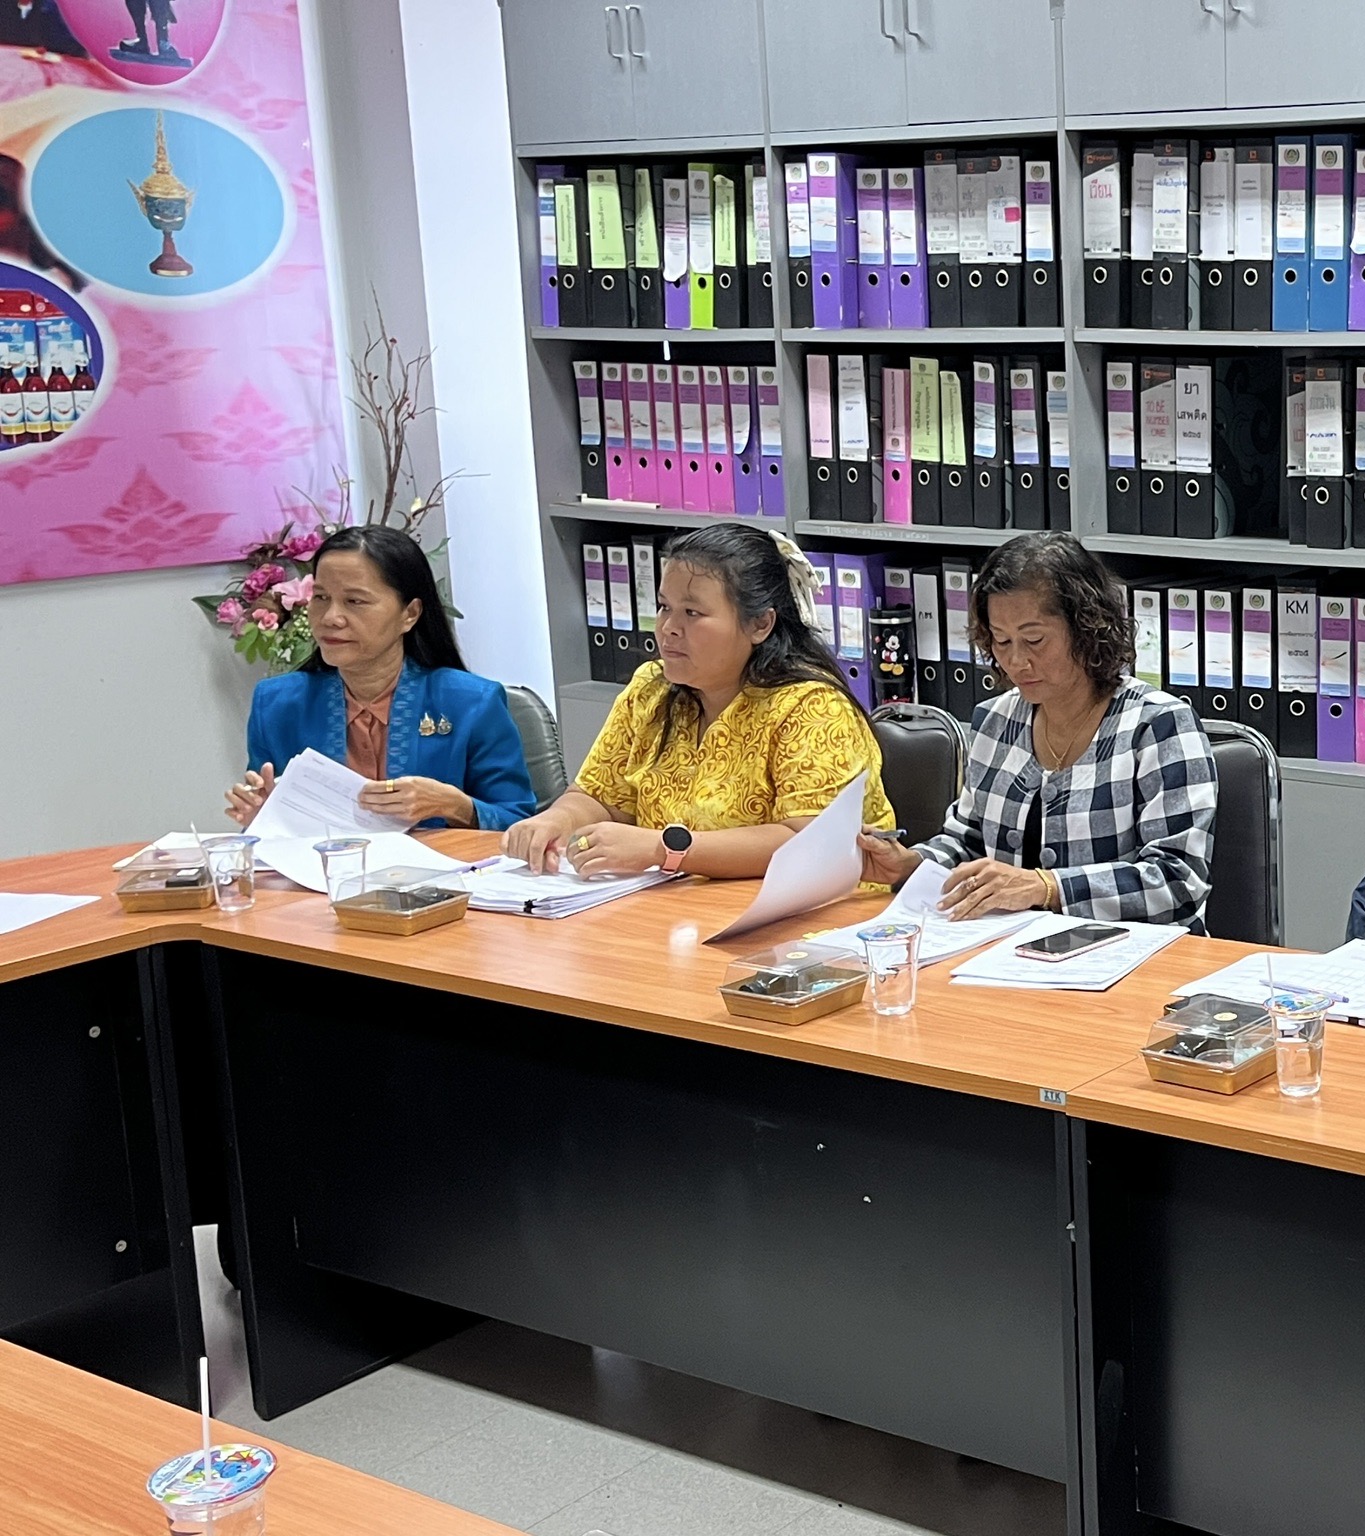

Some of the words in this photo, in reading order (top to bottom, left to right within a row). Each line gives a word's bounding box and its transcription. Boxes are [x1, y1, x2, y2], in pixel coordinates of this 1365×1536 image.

[1184, 383, 1199, 395] ยา
[1177, 409, 1208, 420] เสพติด
[1286, 600, 1308, 614] KM
